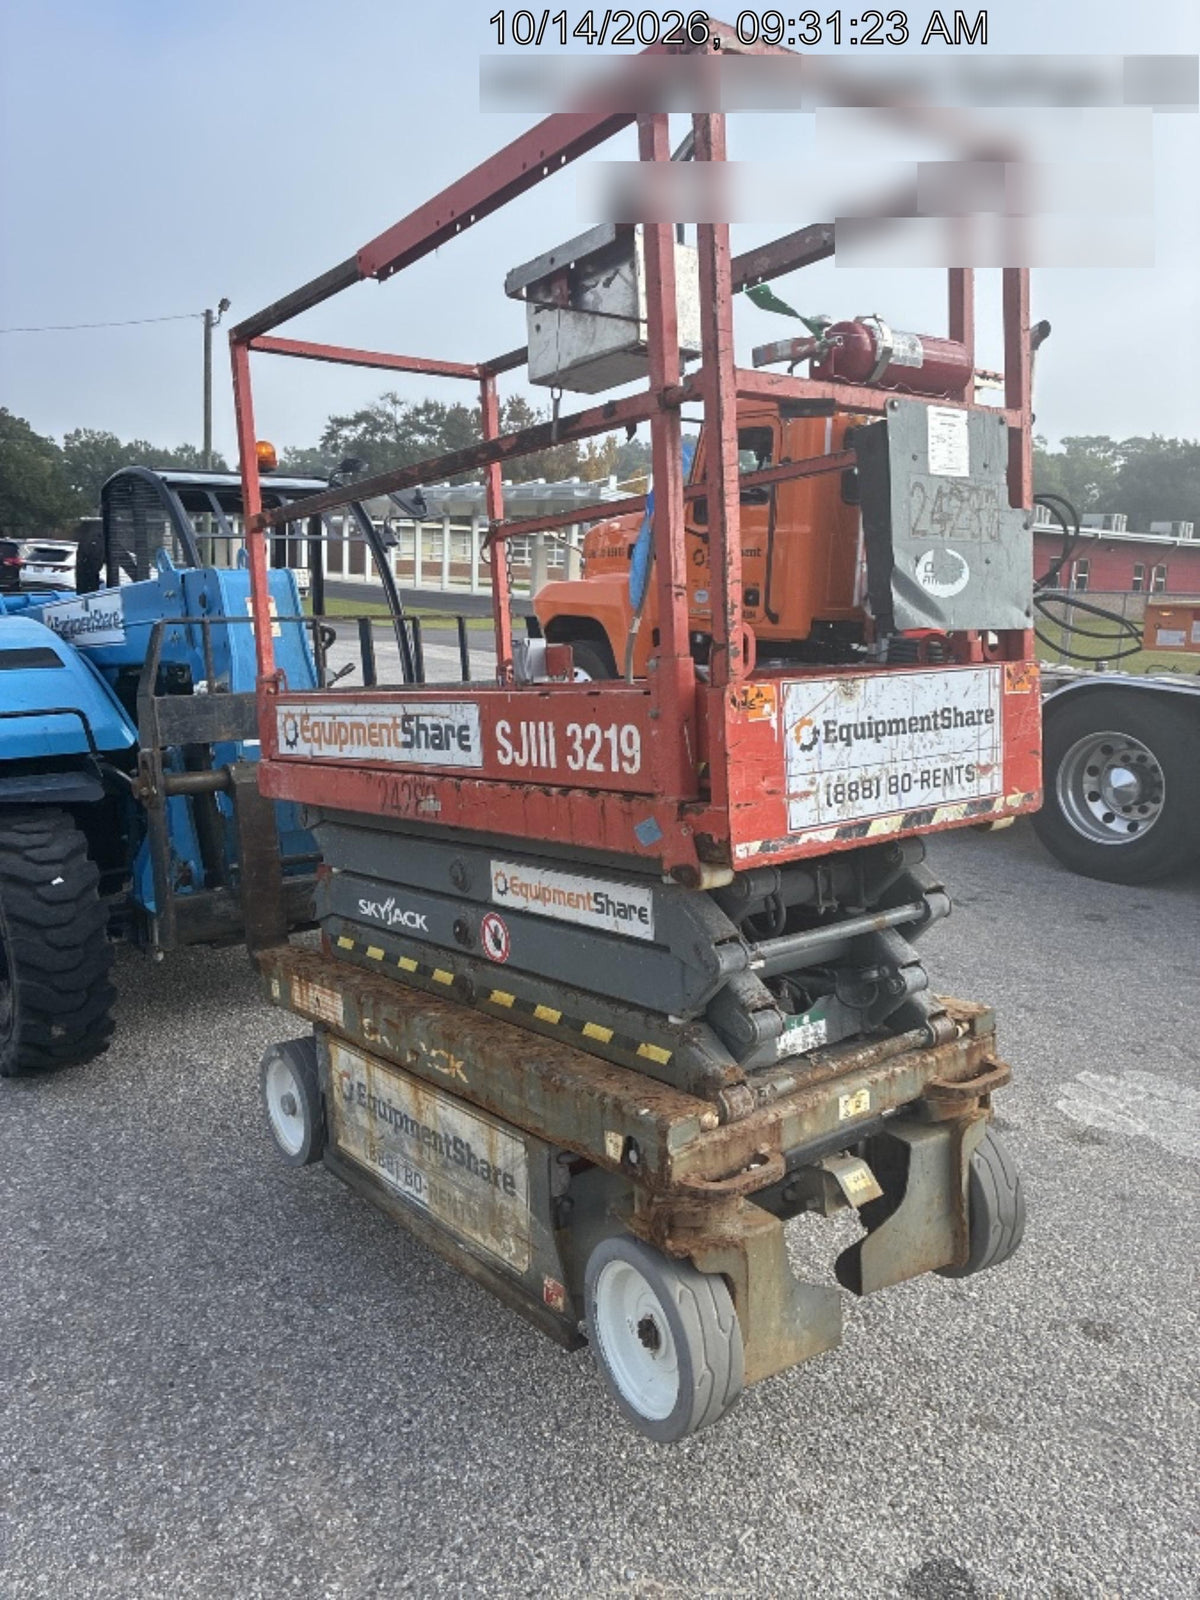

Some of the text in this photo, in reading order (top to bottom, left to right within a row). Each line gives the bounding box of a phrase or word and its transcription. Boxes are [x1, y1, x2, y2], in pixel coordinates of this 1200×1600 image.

[300, 714, 472, 752] EquipmentShare
[566, 723, 641, 774] 3219
[822, 707, 995, 746] EquipmentShare
[825, 763, 976, 808] (888) 80-RENTS
[358, 897, 429, 932] SKYJACK
[510, 876, 649, 925] EquipmentShare
[357, 1083, 517, 1197] EquipmentShare
